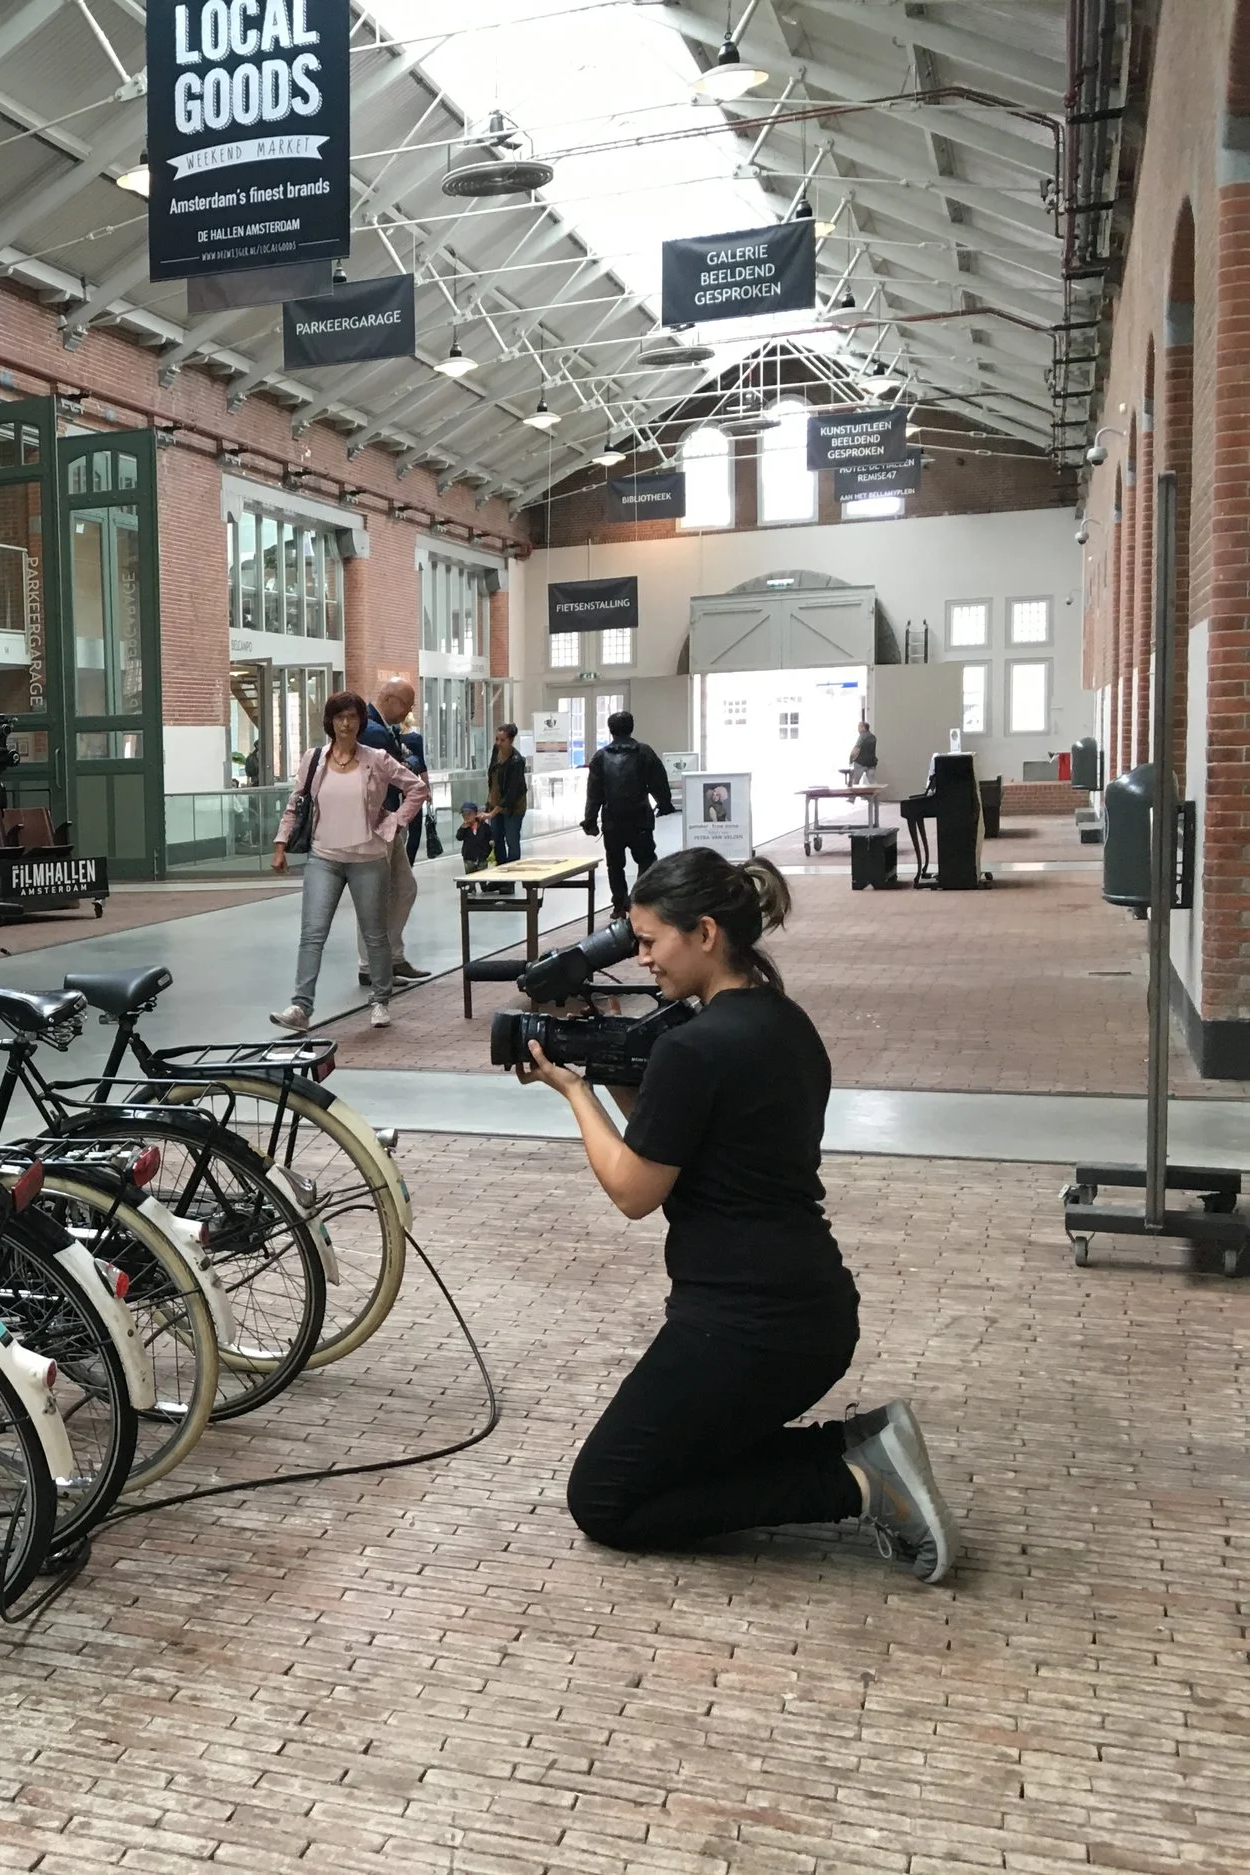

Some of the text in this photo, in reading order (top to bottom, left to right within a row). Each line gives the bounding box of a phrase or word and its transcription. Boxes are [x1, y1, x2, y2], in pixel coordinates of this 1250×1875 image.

[175, 0, 321, 65] LOCAL
[175, 52, 323, 135] GOODS
[186, 137, 309, 170] WEEKEND MARKET
[170, 177, 330, 214] Amsterdam's finest brands
[197, 218, 300, 242] DE HALLEN AMSTERDAM
[706, 245, 768, 265] GALERIE
[700, 263, 775, 286] BEELDEND
[694, 282, 781, 305] GESPROKEN
[296, 310, 402, 336] PARKEERGARAGE
[820, 421, 892, 437] KUNSTUITLEEN
[831, 434, 881, 447] BEELDEND
[827, 446, 885, 459] GESPROKEN
[857, 471, 897, 482] REMISE47
[621, 492, 672, 504] BIBLIOTHEEK
[854, 492, 867, 500] HET
[868, 488, 916, 499] BELLAMYPLEIN
[556, 599, 631, 613] FIETSENSTALLING
[27, 556, 43, 706] PARKEERGARAGE
[20, 884, 87, 896] AMSTERDAM
